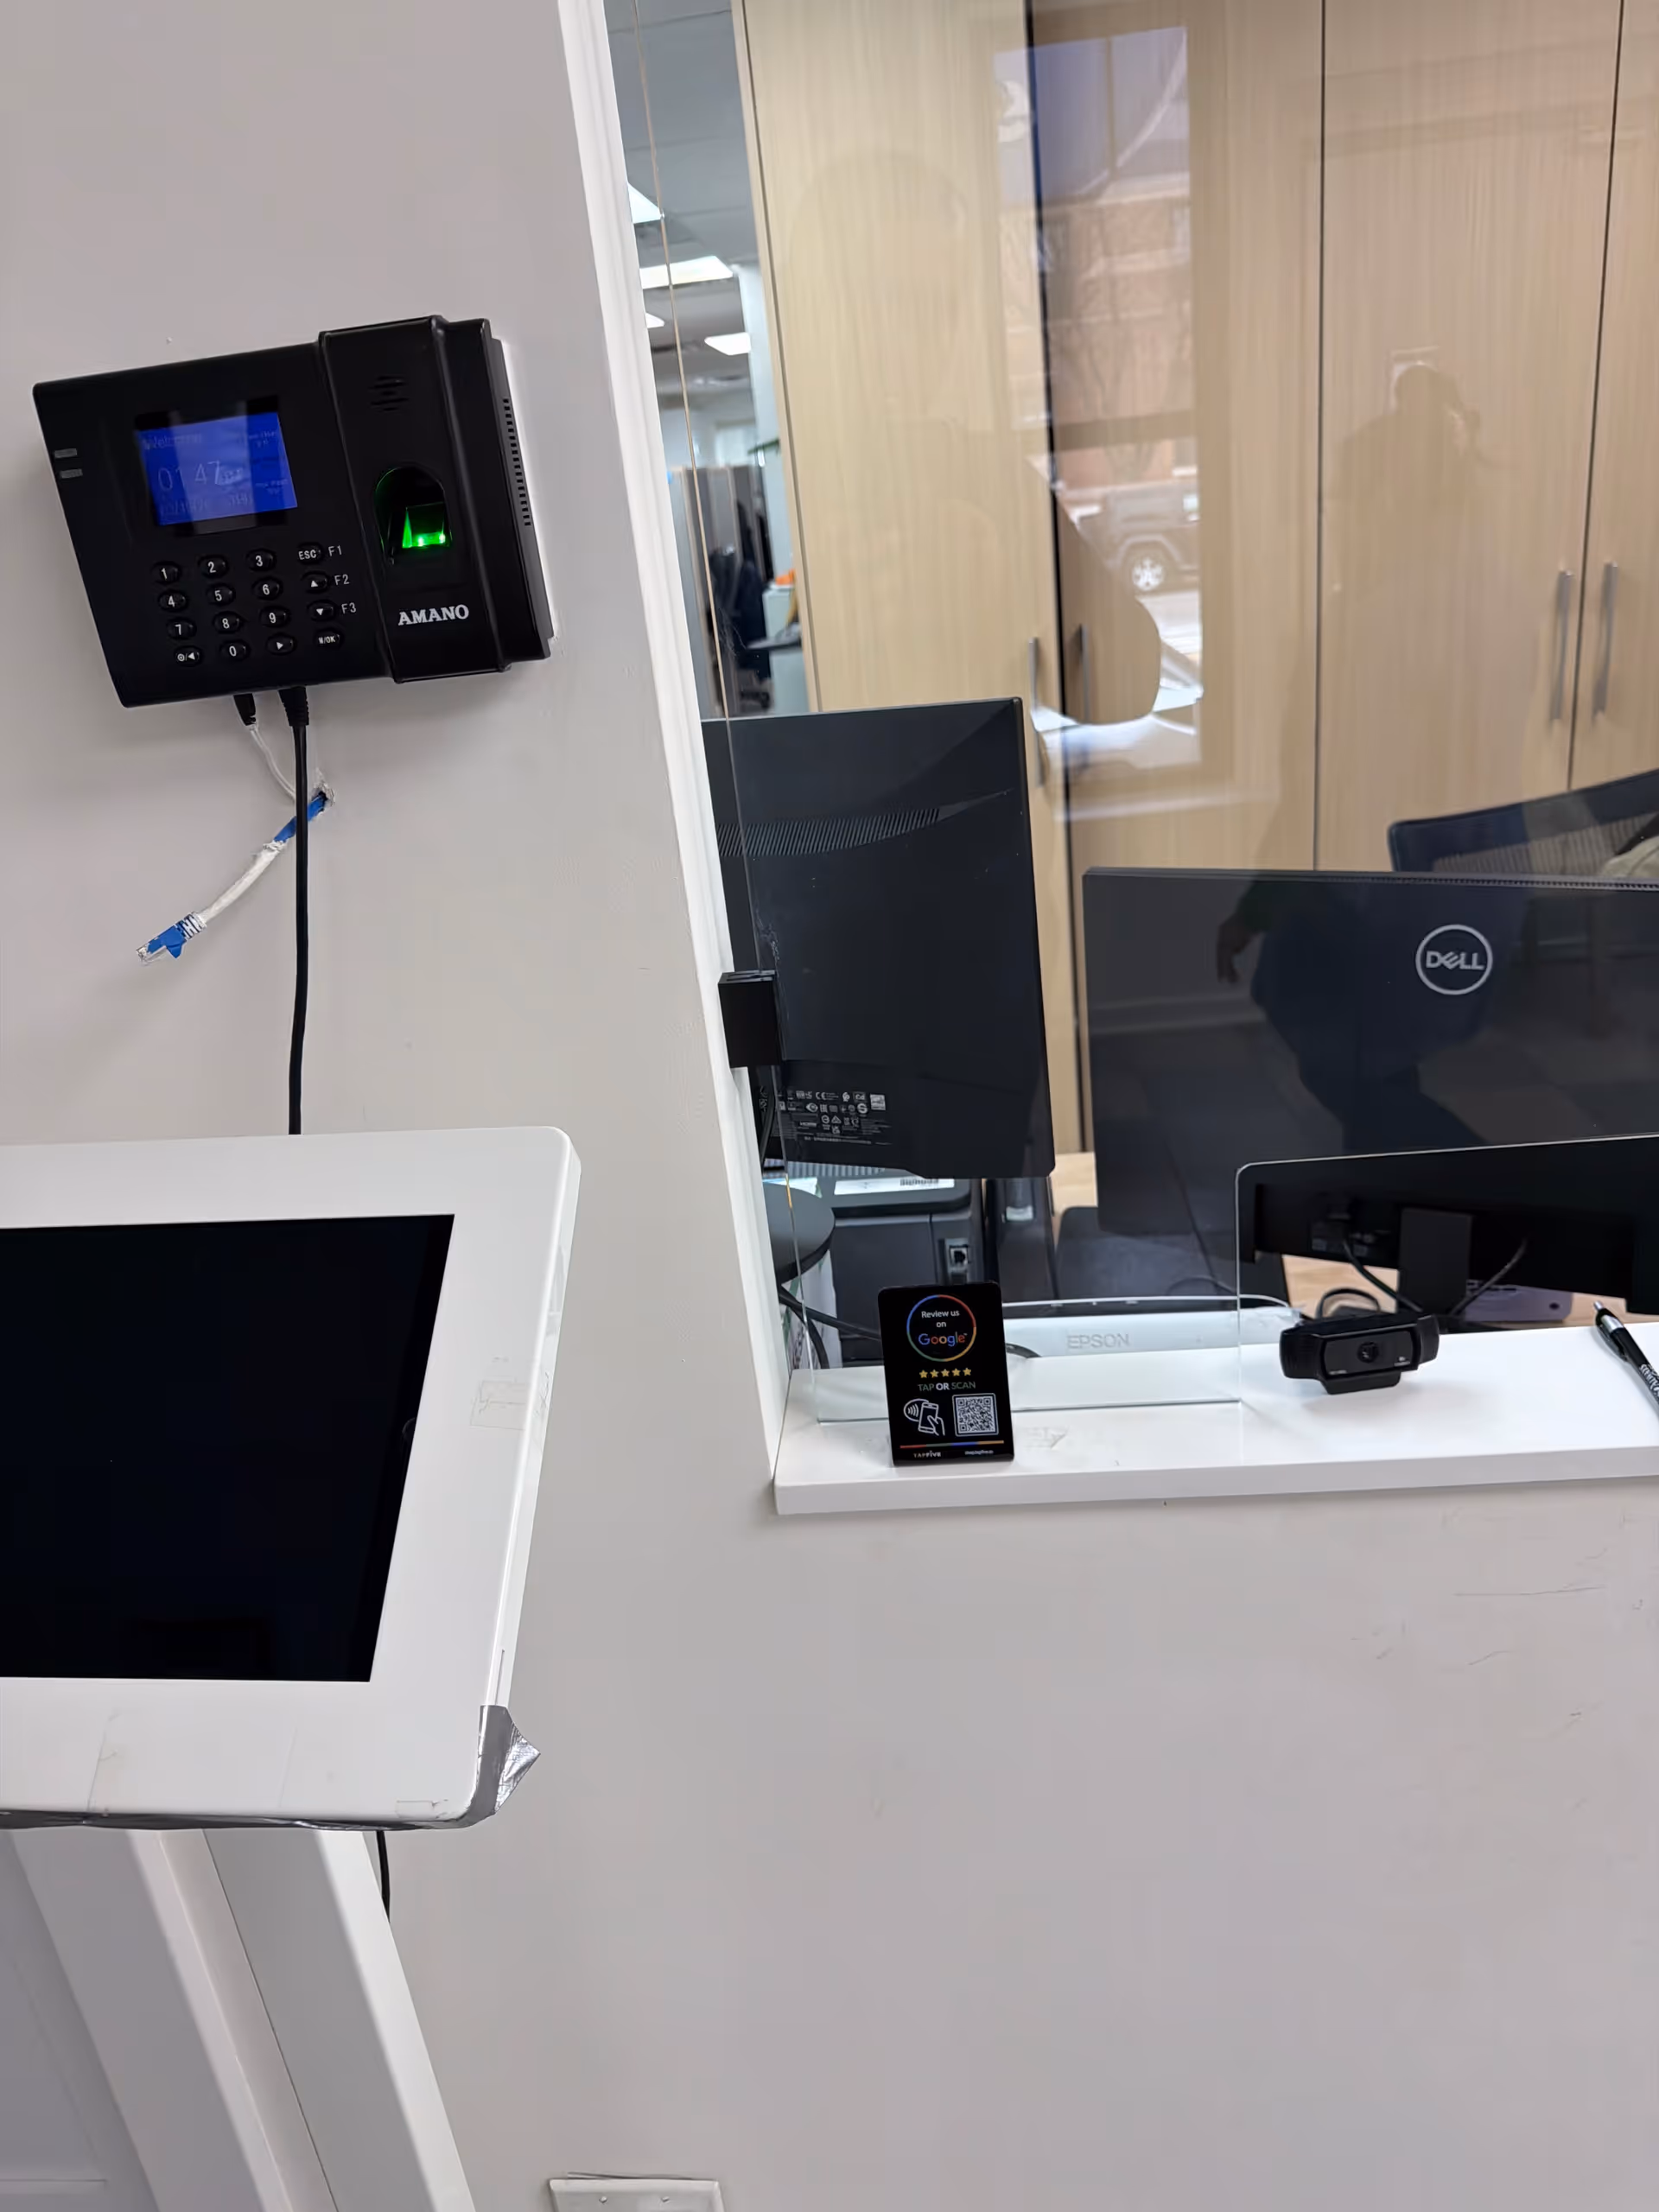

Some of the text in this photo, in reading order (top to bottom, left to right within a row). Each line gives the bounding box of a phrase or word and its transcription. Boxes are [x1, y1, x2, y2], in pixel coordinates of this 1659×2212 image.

[161, 544, 342, 580] 1 2 3 ESC F1
[168, 574, 350, 607] 4 5 6 F2
[175, 601, 357, 636] 7 8 9 F3
[397, 604, 469, 626] AMANO
[229, 645, 237, 657] 0
[1426, 950, 1484, 970] DELL
[920, 1310, 950, 1319] Review
[918, 1332, 966, 1346] Google
[1067, 1333, 1130, 1349] EPSON
[917, 1381, 976, 1392] TAP OR SCAN
